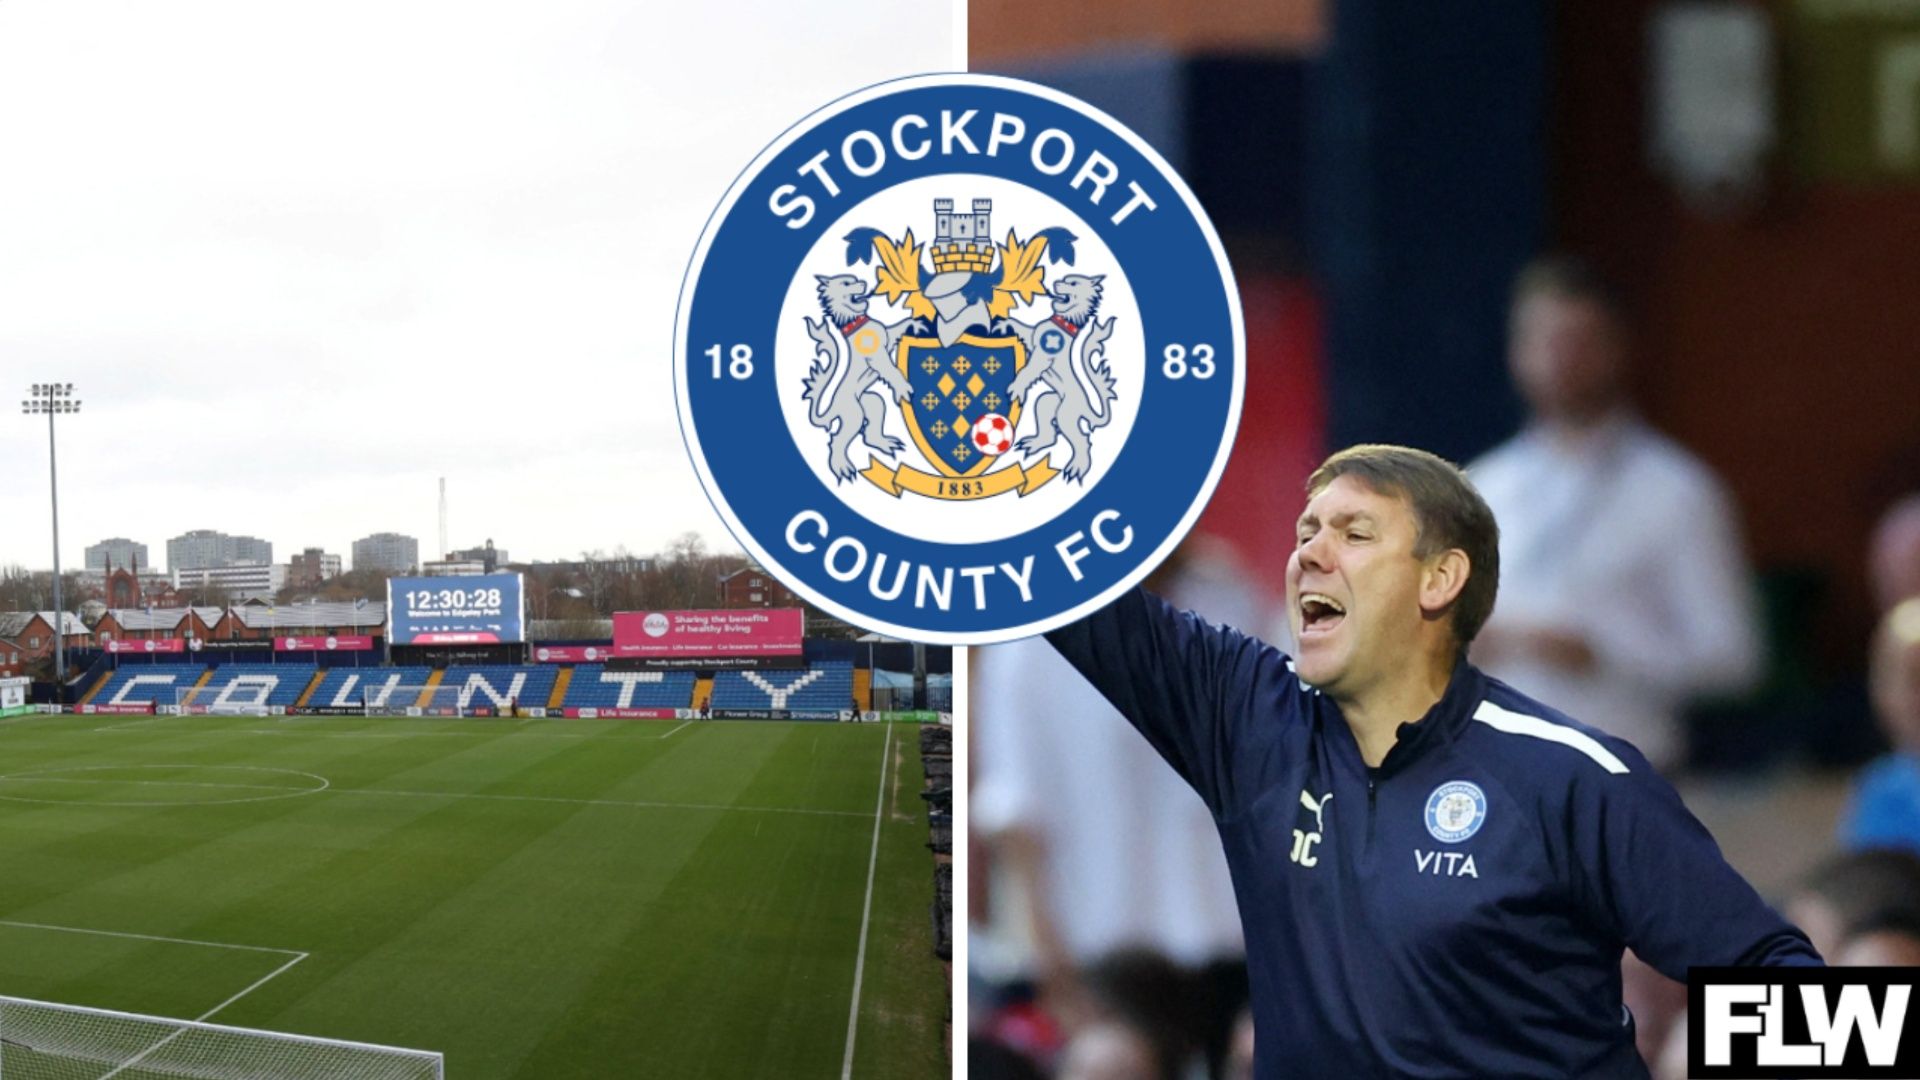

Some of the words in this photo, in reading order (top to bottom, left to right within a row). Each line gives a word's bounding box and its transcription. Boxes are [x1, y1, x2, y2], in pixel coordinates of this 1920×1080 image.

[405, 588, 502, 609] 12:30:28
[452, 609, 481, 618] Edgeley
[483, 608, 500, 616] Park
[675, 616, 708, 625] Sharing
[729, 614, 769, 623] benefits
[687, 625, 721, 634] healthy
[724, 624, 751, 634] living
[619, 709, 657, 717] Insurance
[1414, 849, 1479, 878] VITA
